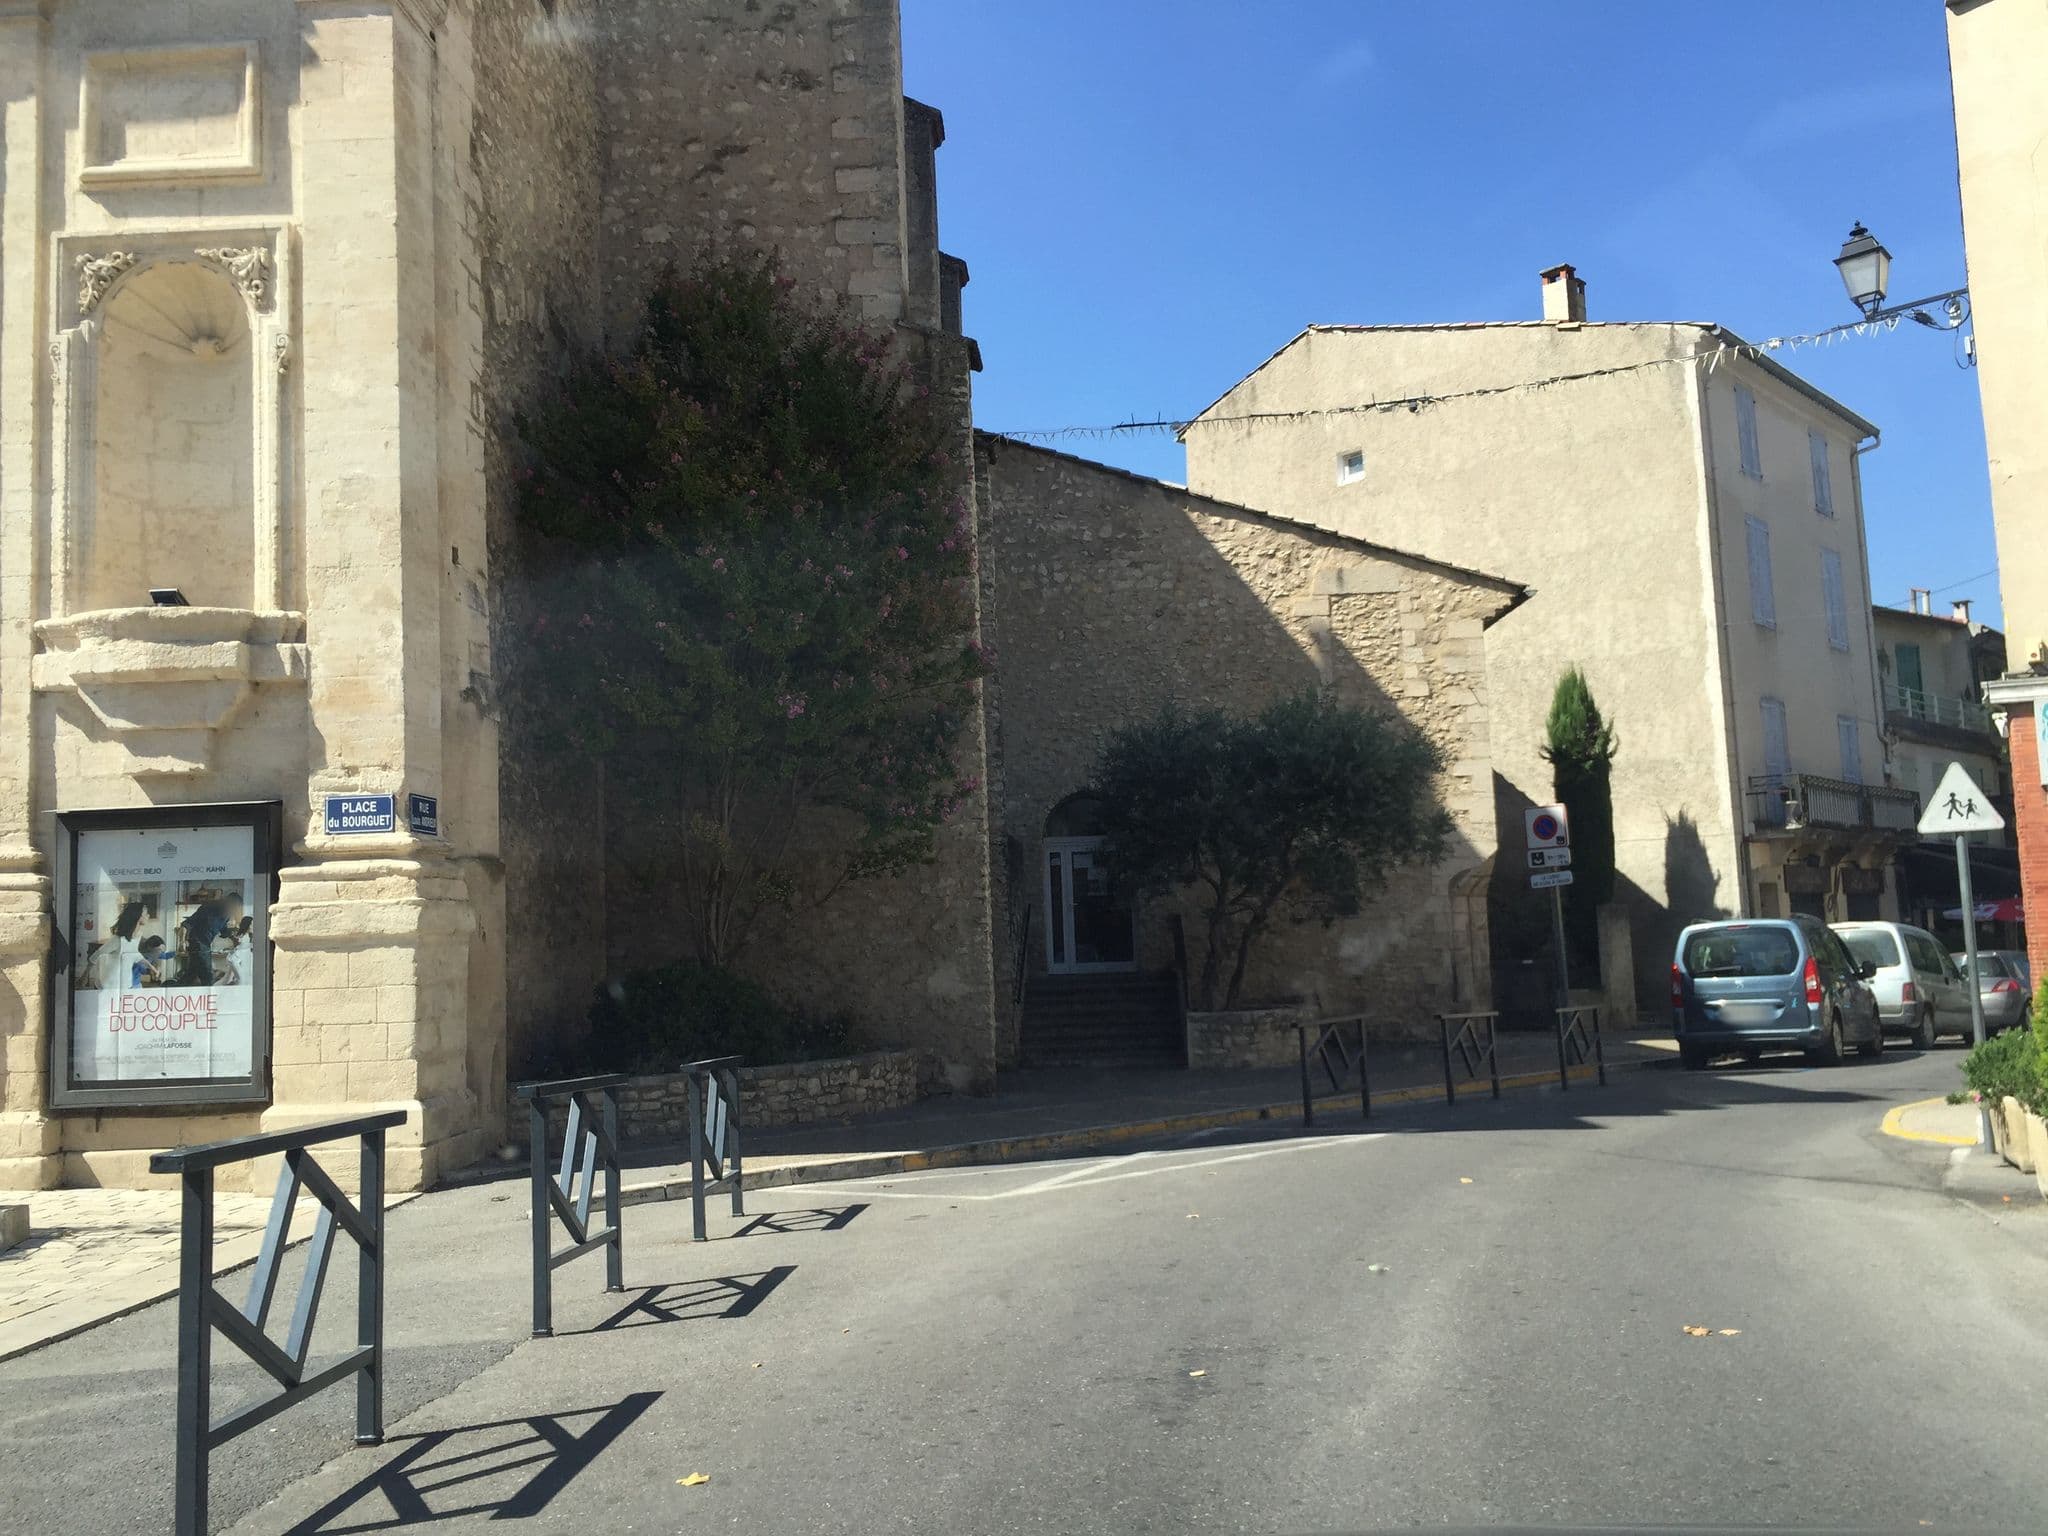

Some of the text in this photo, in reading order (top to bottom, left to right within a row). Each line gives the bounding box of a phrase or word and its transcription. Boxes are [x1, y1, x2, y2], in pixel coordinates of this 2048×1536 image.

[341, 801, 377, 813] PLACE
[419, 801, 430, 814] RUE
[328, 814, 391, 828] du BOURGUET
[143, 867, 162, 875] BEJO
[179, 864, 226, 874] CÉDRIC KAHN
[110, 994, 218, 1014] L'ÉCONOMIE
[109, 1012, 218, 1032] DU COUPLE
